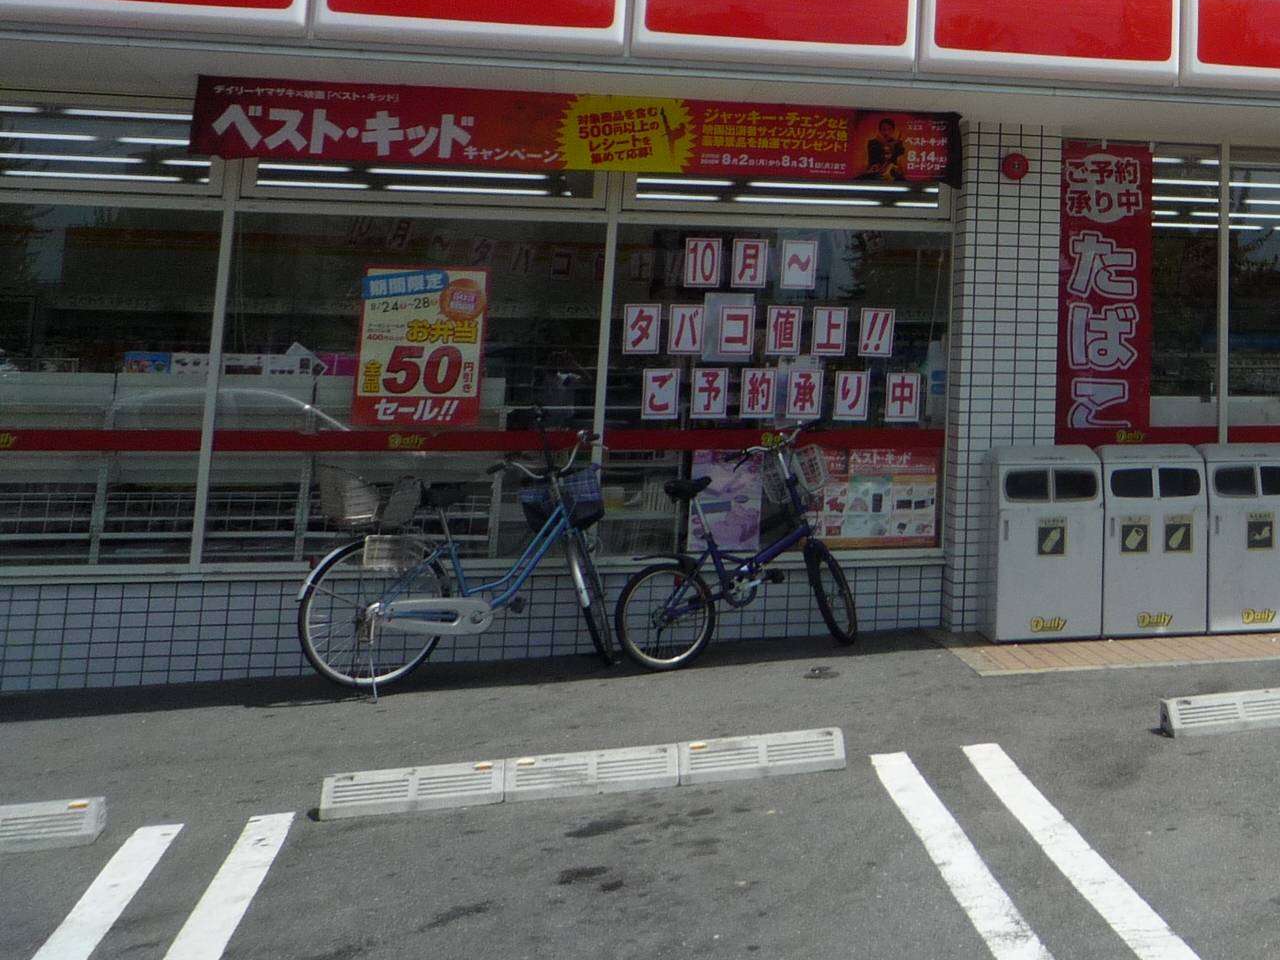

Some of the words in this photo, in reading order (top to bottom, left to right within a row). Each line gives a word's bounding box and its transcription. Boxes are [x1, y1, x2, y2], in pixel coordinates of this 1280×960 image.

[212, 104, 475, 159] ベスト・キッド
[579, 121, 660, 139] 500円以上の
[463, 146, 560, 163] キャンペーン
[589, 135, 652, 153] レシートを
[1065, 157, 1140, 186] ご予約
[1065, 188, 1143, 217] 承り中
[369, 273, 444, 296] 期間限定
[406, 319, 478, 344] お弁当
[1066, 230, 1139, 429] たばこ
[363, 359, 382, 393] 全品
[382, 345, 463, 395] 50
[462, 362, 474, 394] 円引き
[649, 371, 914, 415] ご予約承り中
[374, 398, 459, 422] セール!!
[1030, 616, 1067, 633] Daily
[1137, 611, 1173, 628] Daily
[1241, 608, 1277, 624] Daily
